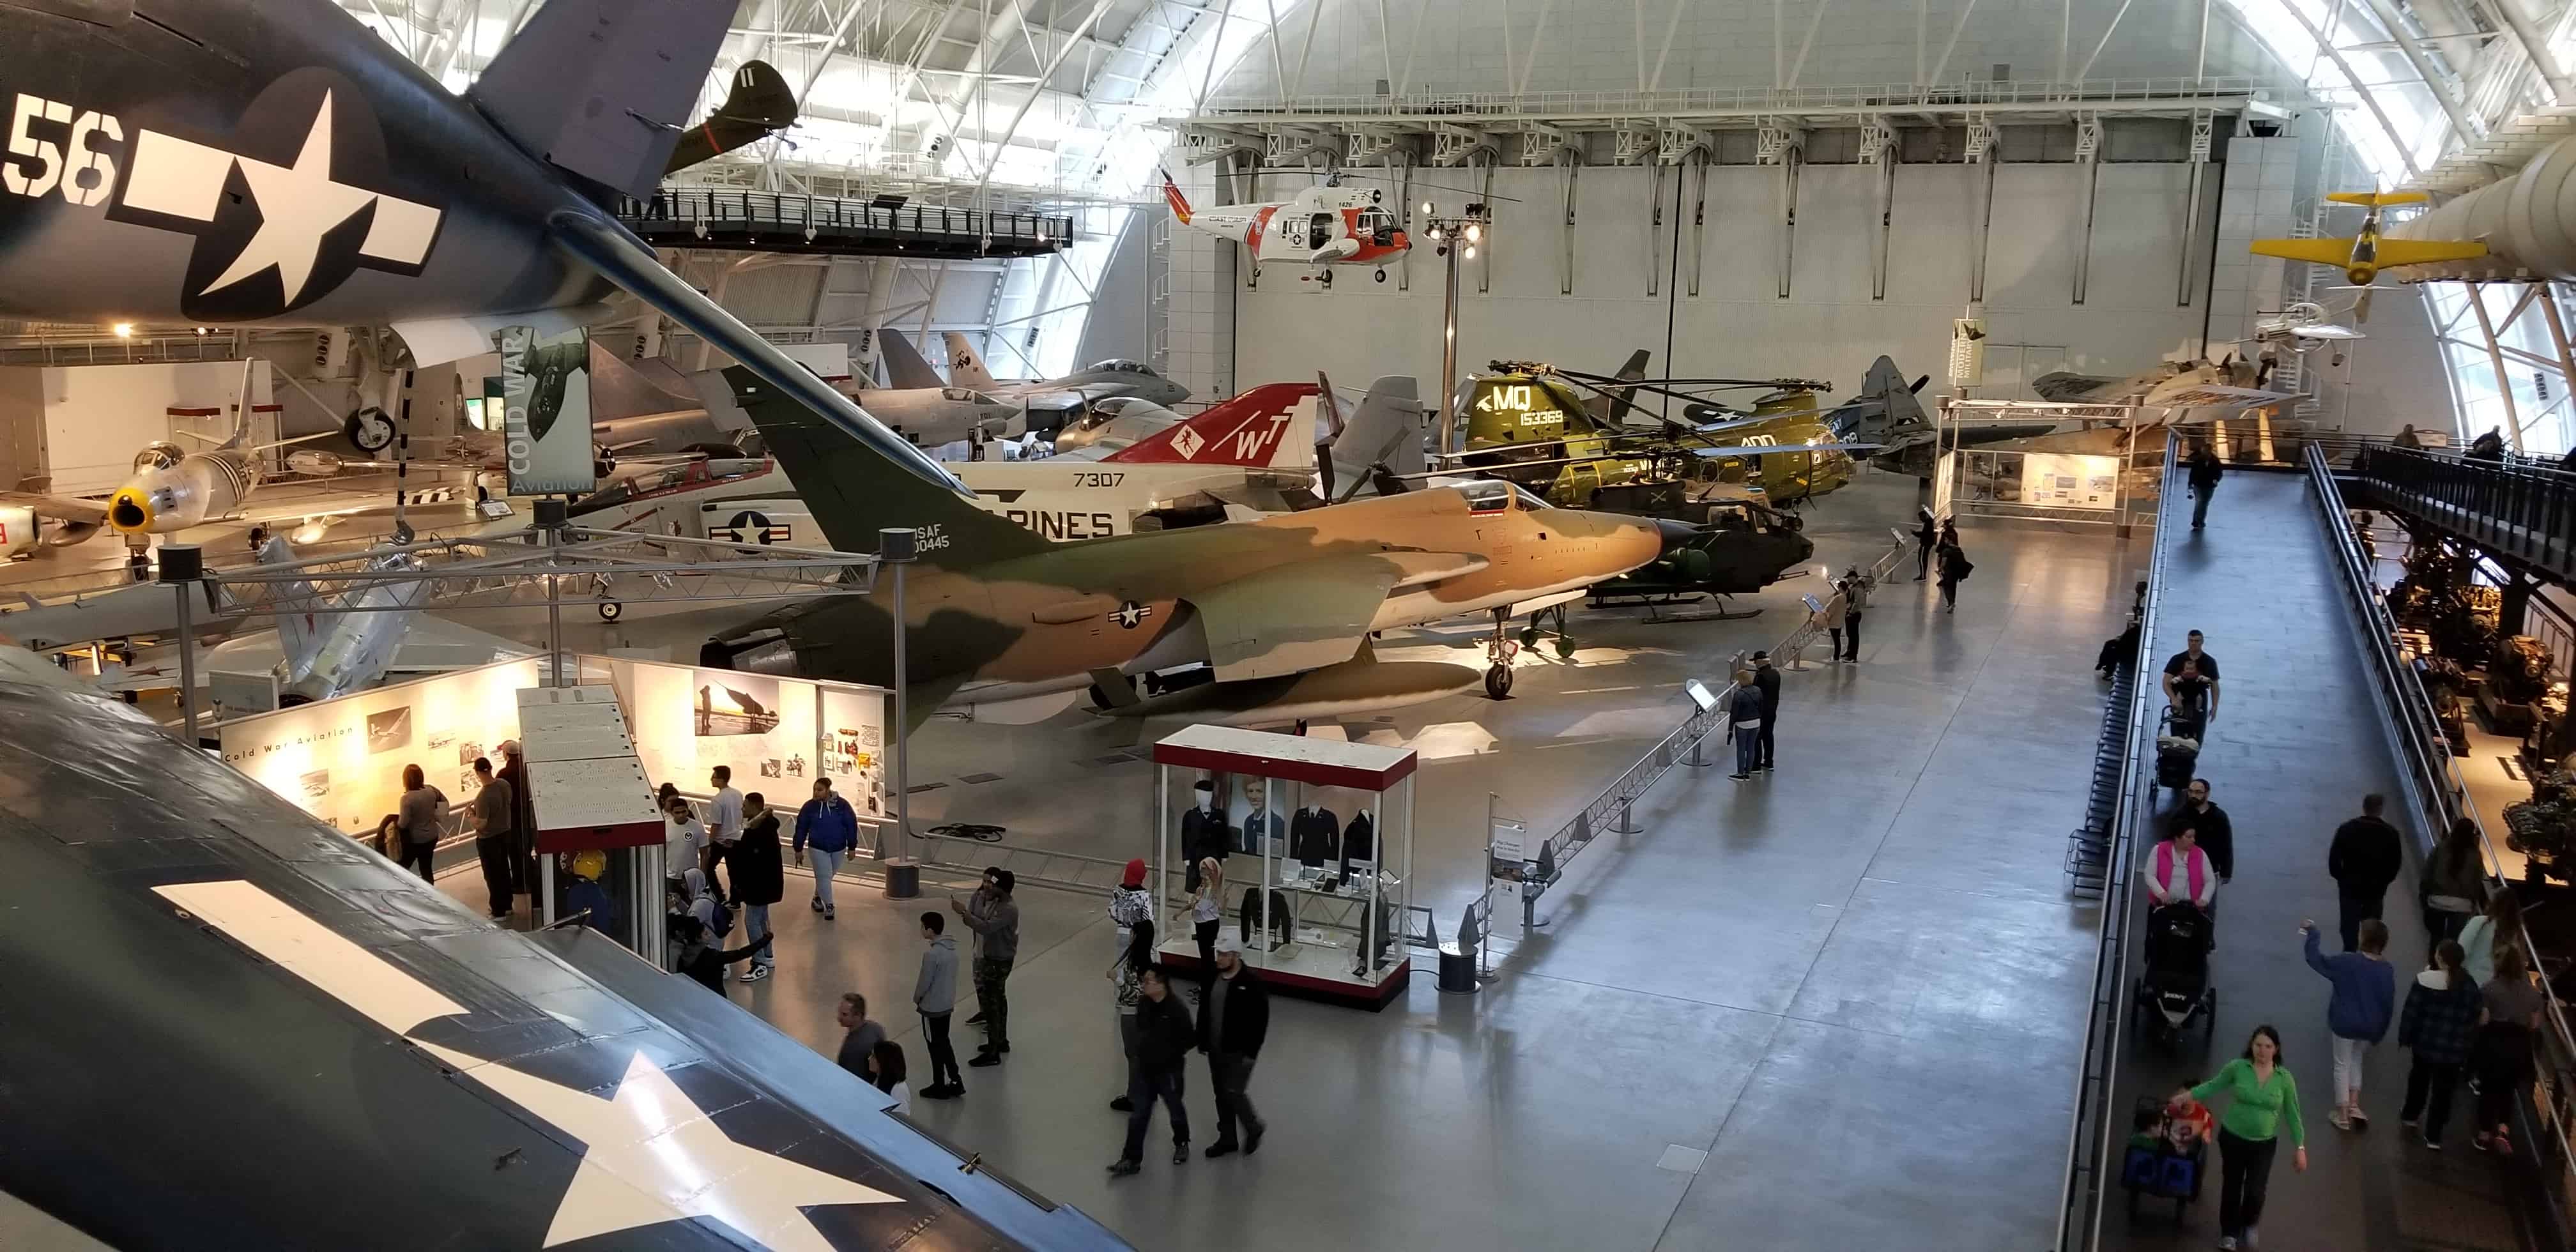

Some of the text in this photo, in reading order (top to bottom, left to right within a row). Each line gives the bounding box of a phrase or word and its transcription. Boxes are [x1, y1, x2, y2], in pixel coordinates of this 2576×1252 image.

[3, 93, 124, 207] 56
[502, 337, 531, 476] COLD WAR
[1493, 385, 1531, 411] MQ
[1521, 410, 1564, 426] 153369
[511, 478, 593, 492] Aviation
[1074, 473, 1124, 487] 7307
[225, 728, 353, 762] Cold War Aviation
